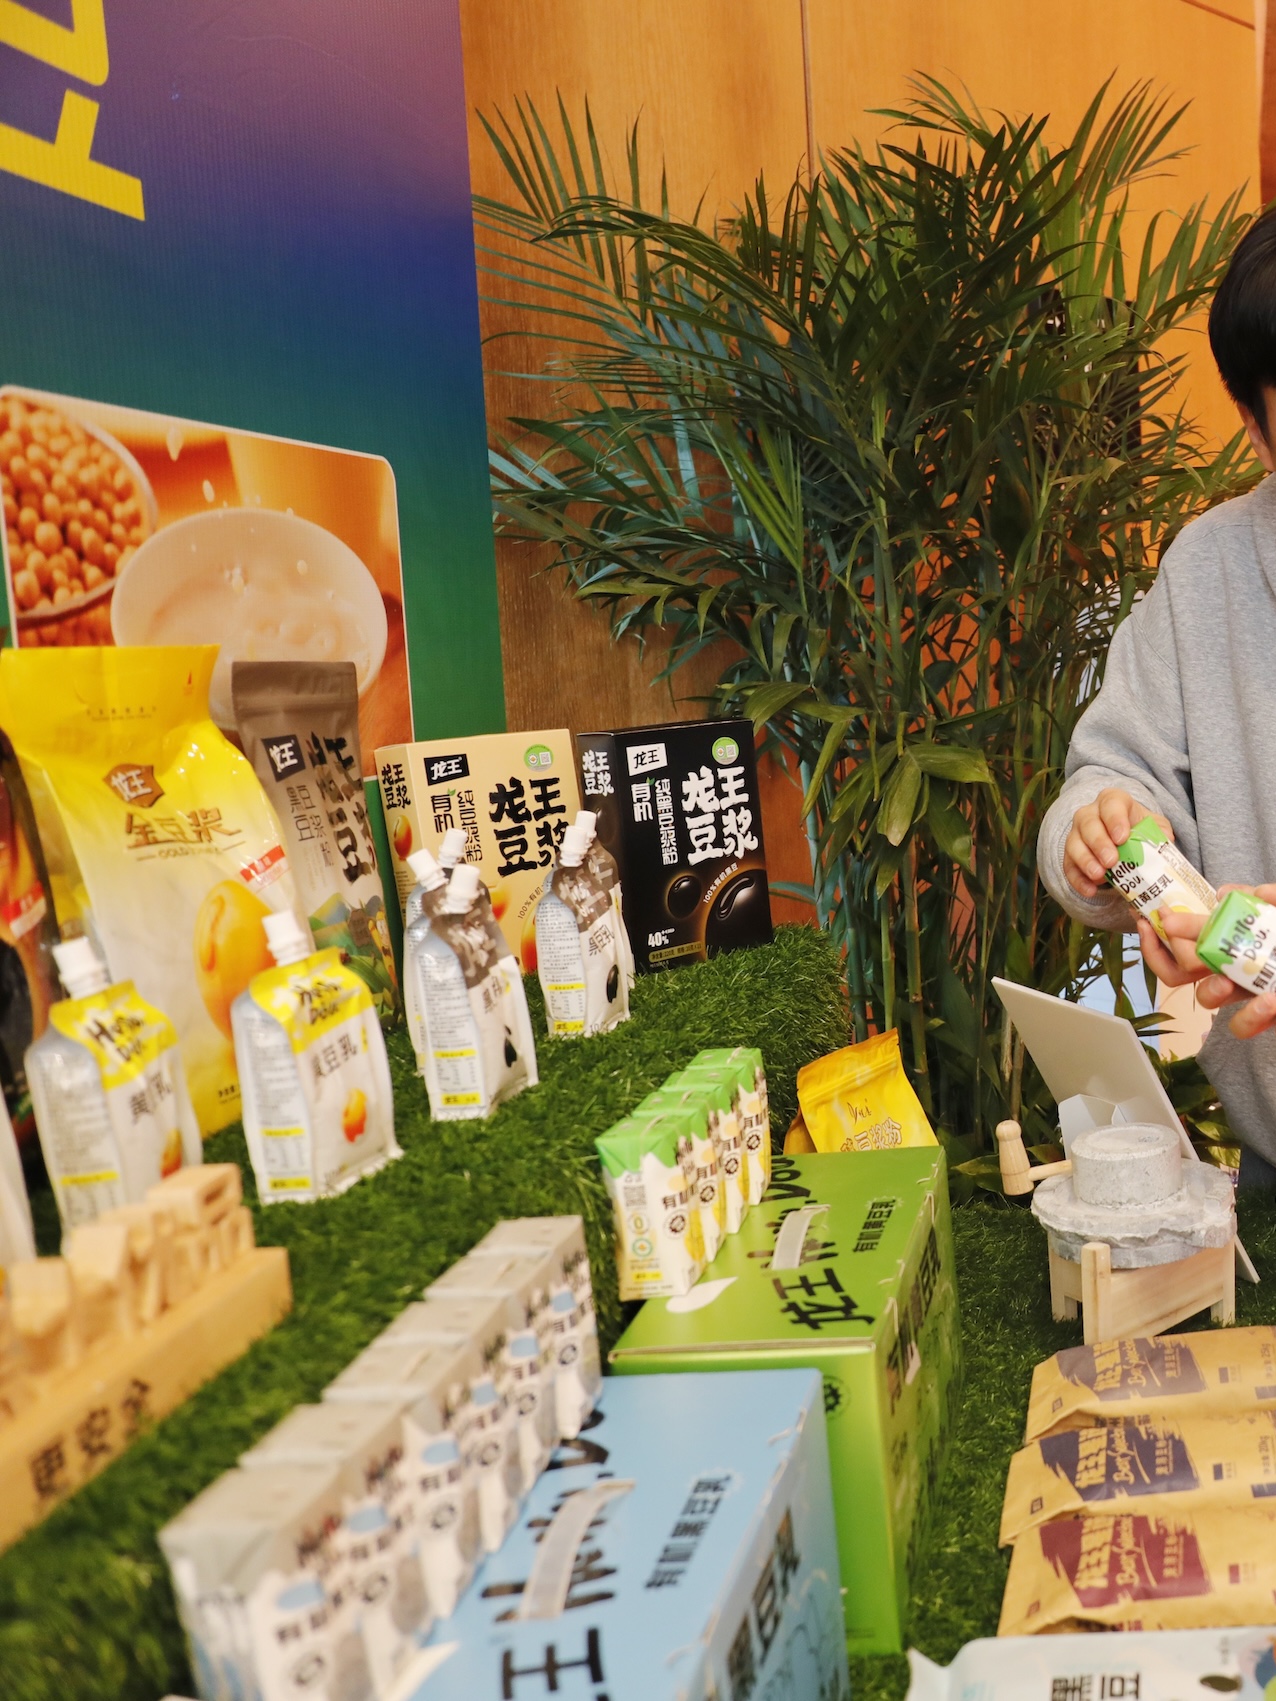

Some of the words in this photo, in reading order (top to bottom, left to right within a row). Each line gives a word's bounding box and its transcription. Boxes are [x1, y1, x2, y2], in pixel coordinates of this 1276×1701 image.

[381, 763, 405, 786] 龙王
[430, 757, 462, 780] 龙王
[582, 750, 610, 773] 龙王
[634, 750, 659, 769] 龙王
[110, 769, 152, 802] 龙王
[384, 785, 411, 810] 豆浆
[489, 776, 566, 823] 龙王
[585, 772, 614, 796] 豆浆
[631, 782, 653, 822] 有机
[681, 765, 749, 814] 龙王
[125, 807, 242, 849] 金豆浆
[430, 793, 455, 834] 有机
[655, 778, 678, 865] 纯黑豆浆粉
[493, 819, 569, 878] 豆浆
[685, 807, 758, 866] 豆浆
[702, 862, 739, 904] 100%有机黑豆
[772, 1268, 876, 1330] 龙王
